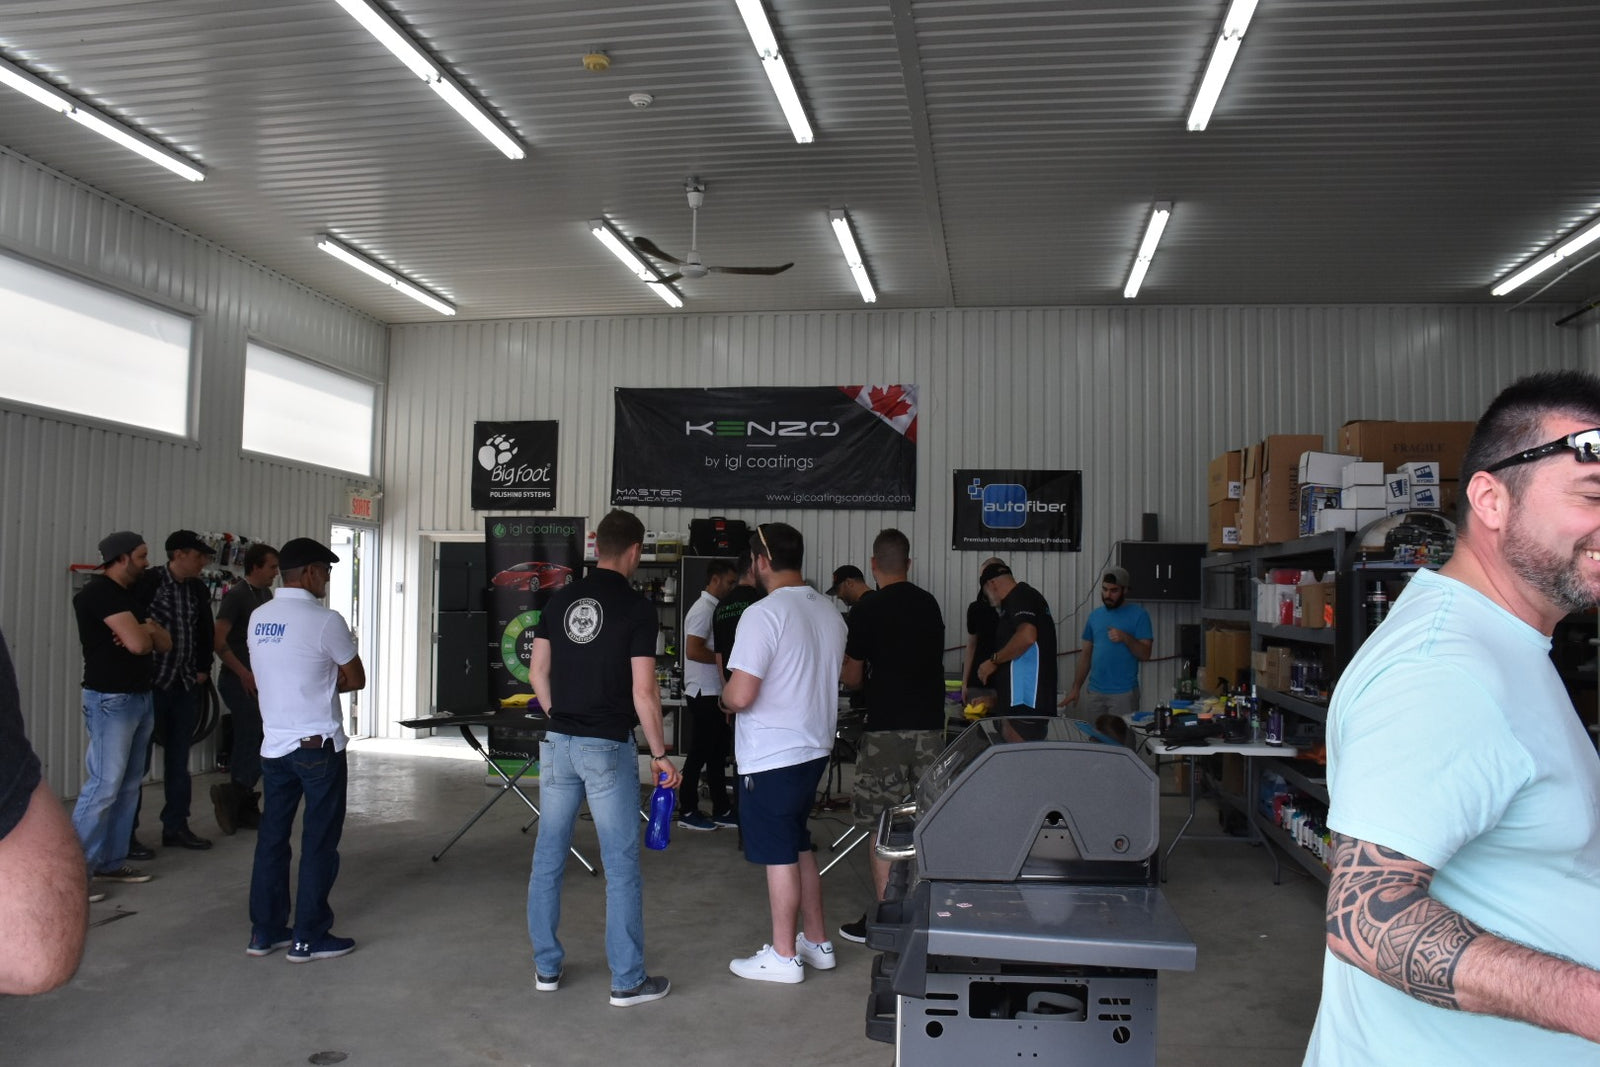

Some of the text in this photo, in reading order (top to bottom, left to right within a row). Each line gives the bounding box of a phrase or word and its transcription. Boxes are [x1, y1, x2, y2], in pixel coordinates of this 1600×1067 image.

[685, 420, 840, 437] KENZO
[705, 454, 814, 471] by igl coatings
[766, 492, 911, 504] www.iglcoatingscanada.com
[984, 500, 1066, 512] autofiber
[509, 522, 576, 537] igl coatings
[255, 623, 286, 636] GYEON
